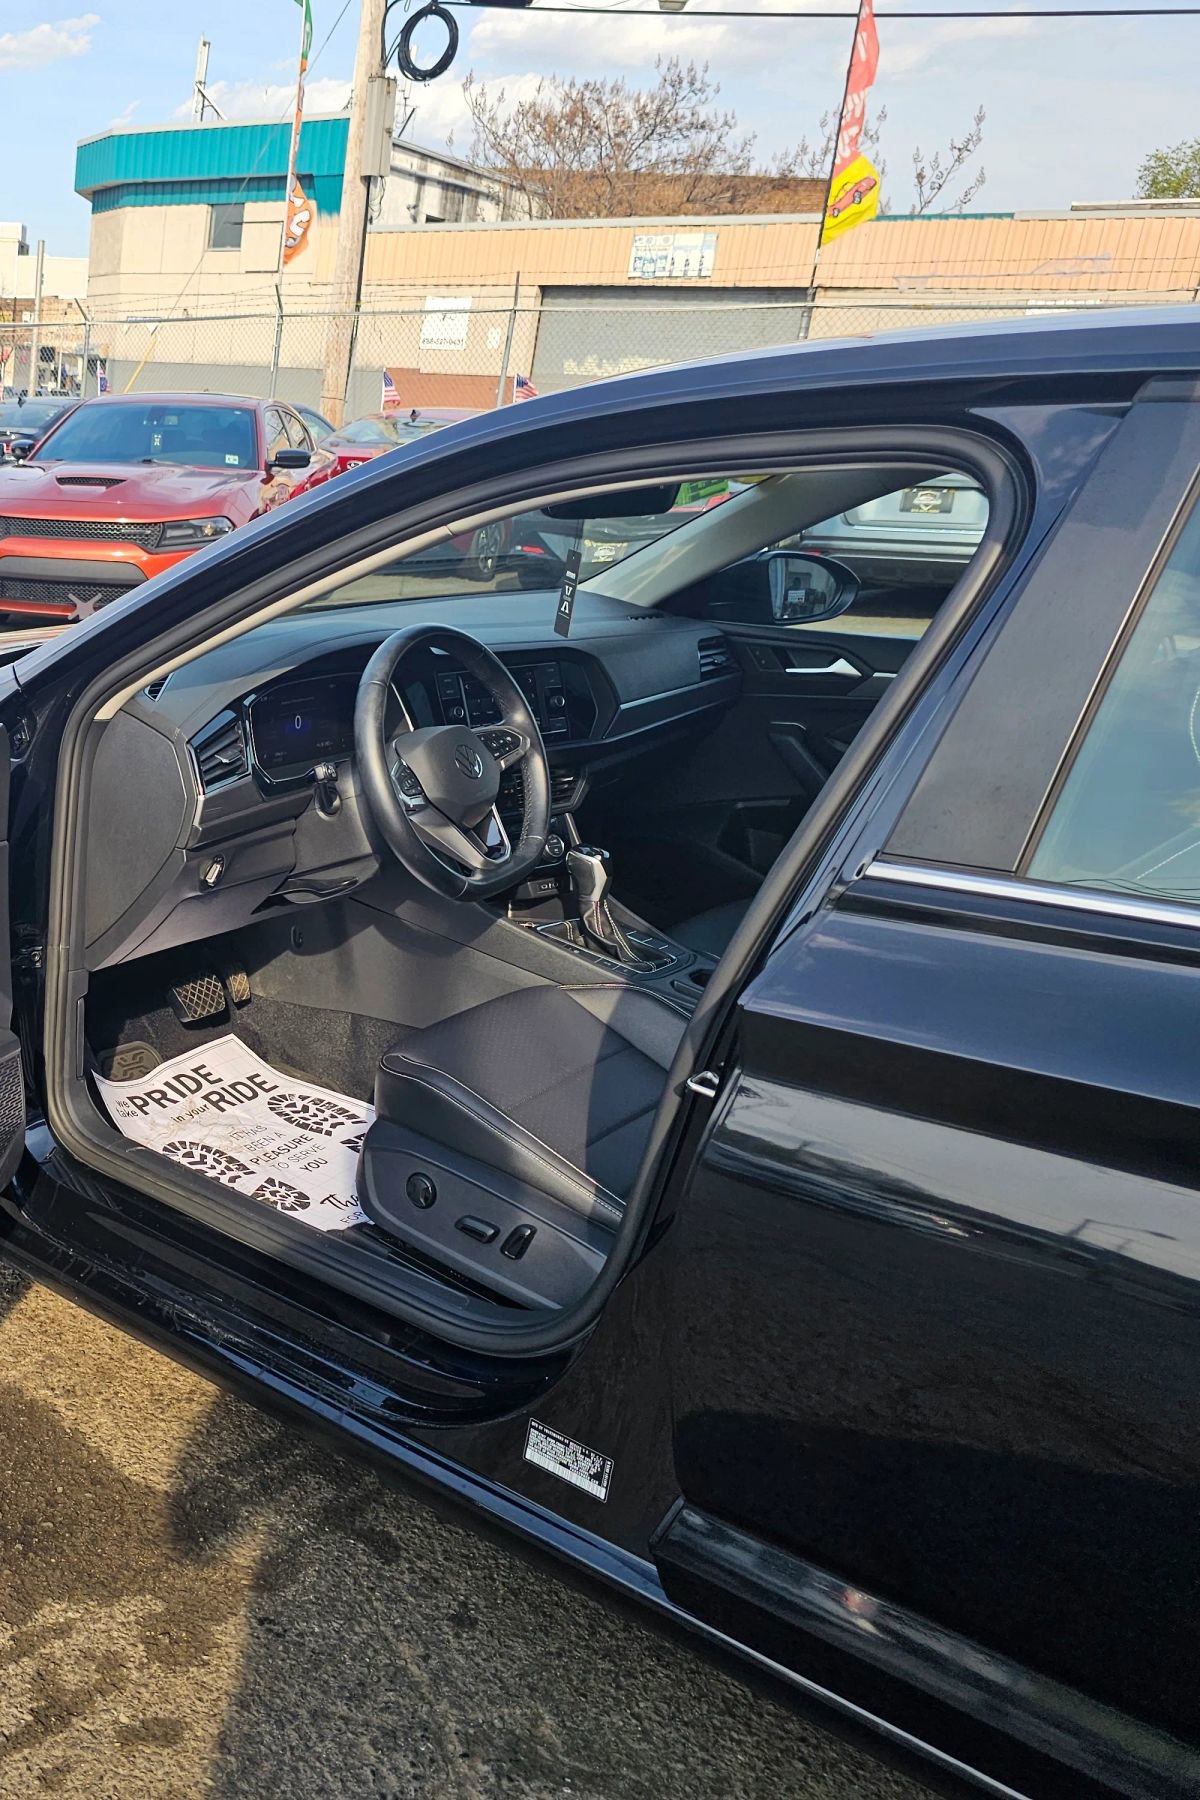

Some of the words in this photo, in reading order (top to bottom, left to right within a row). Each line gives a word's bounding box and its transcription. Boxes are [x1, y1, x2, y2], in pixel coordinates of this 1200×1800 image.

[294, 715, 302, 729] 0
[126, 1064, 224, 1116] PRIDE
[172, 1115, 185, 1124] in
[184, 1103, 210, 1118] your
[201, 1073, 280, 1113] RIDE
[116, 1108, 139, 1119] take
[244, 1135, 276, 1152] BEEN
[274, 1131, 286, 1139] A
[249, 1133, 314, 1166] PLEASURE
[269, 1161, 290, 1172] TO
[287, 1142, 327, 1163] SERVE
[299, 1157, 328, 1172] YOU
[320, 1193, 359, 1211] Tha
